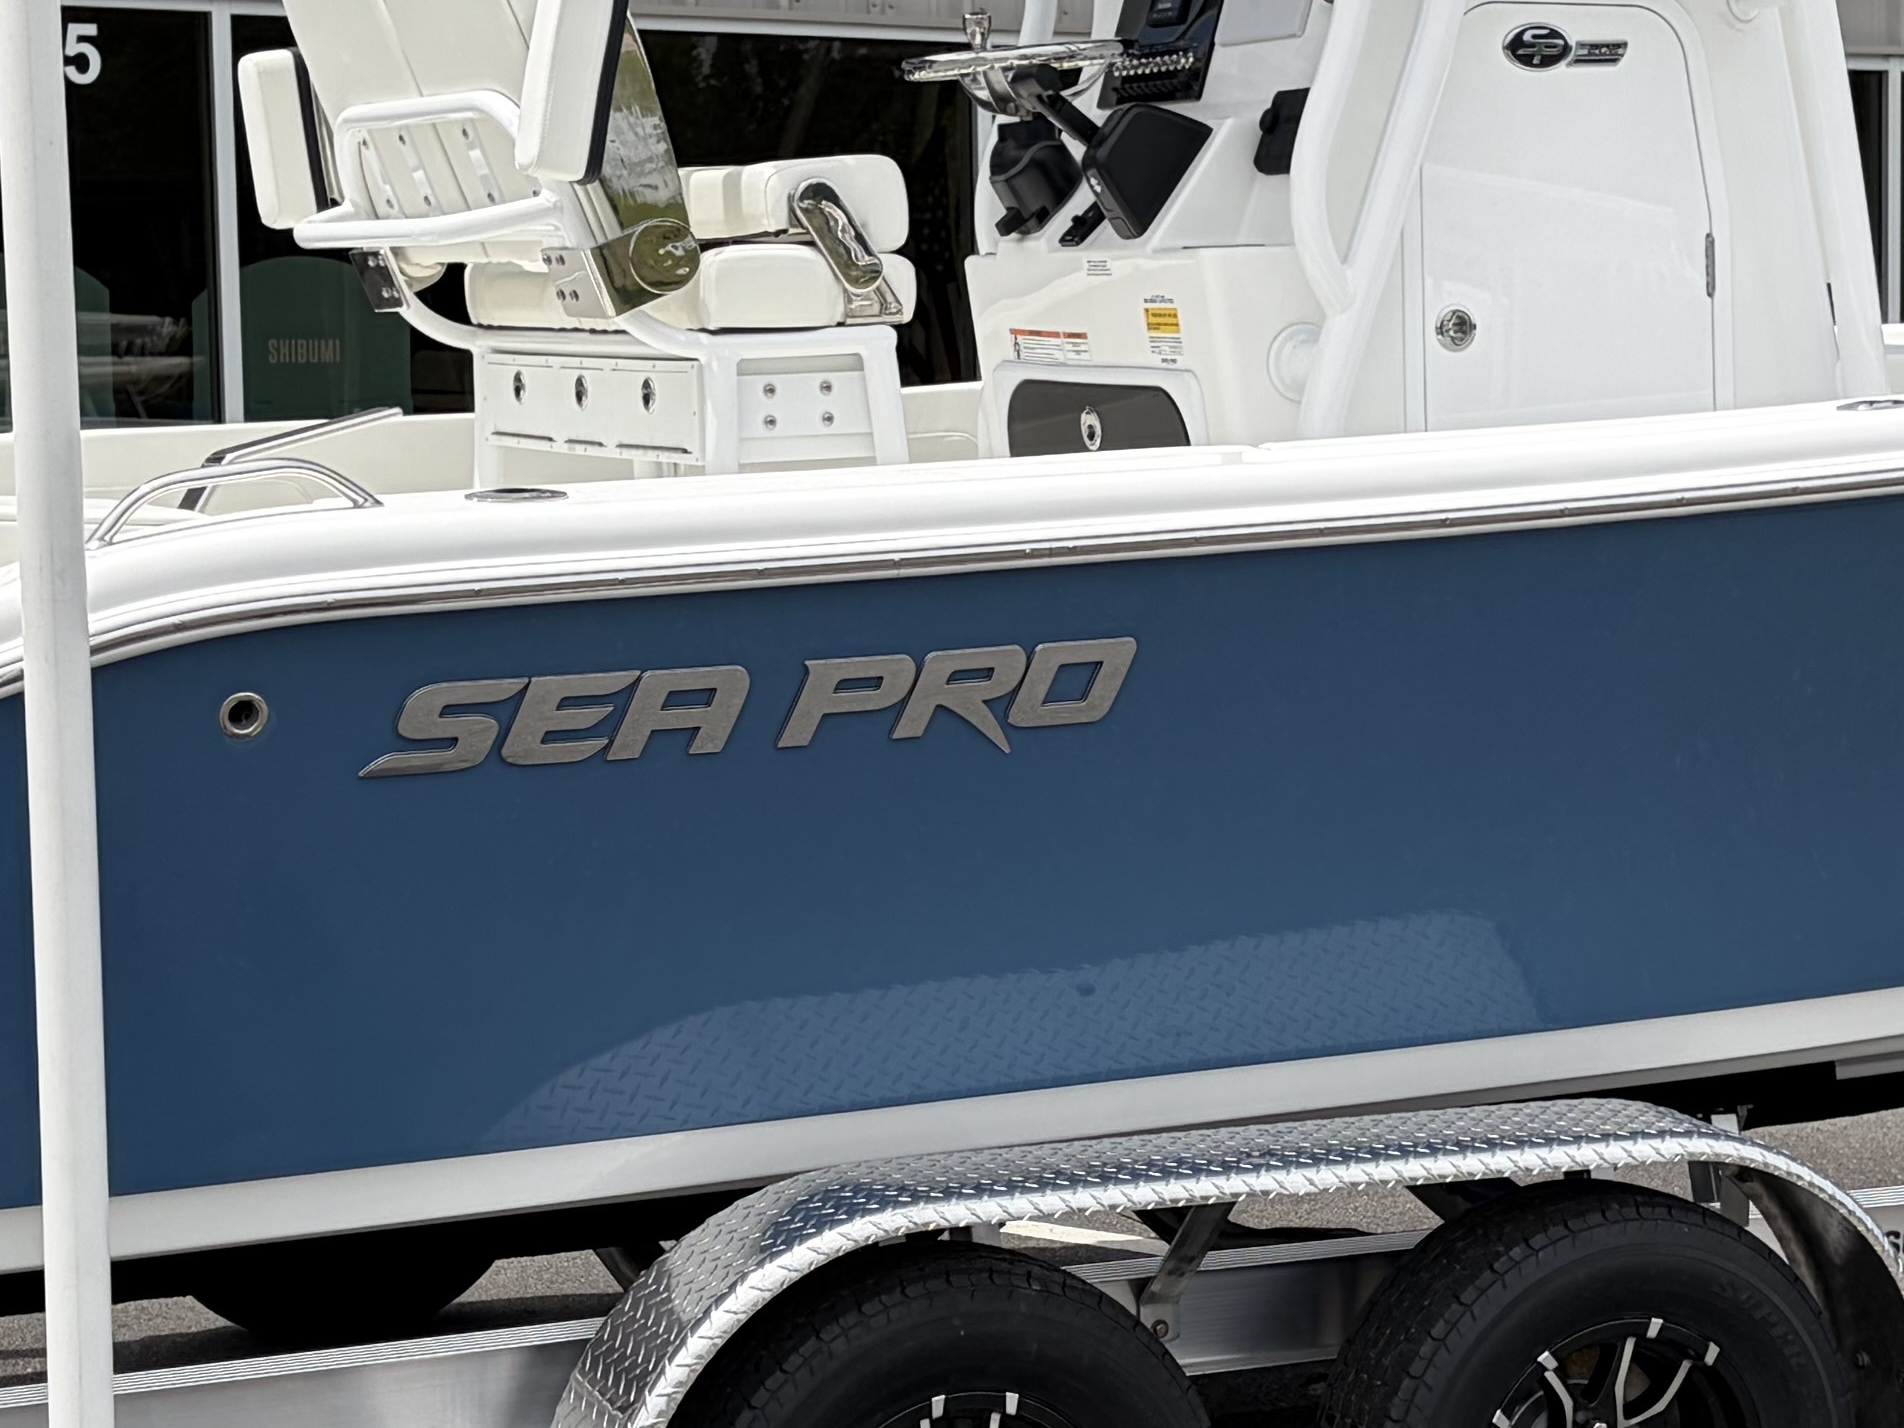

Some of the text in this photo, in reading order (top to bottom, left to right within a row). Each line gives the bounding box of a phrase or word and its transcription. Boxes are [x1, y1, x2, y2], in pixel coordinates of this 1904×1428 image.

[268, 338, 341, 364] SHIBUMI
[358, 636, 1138, 777] SEA PRO
